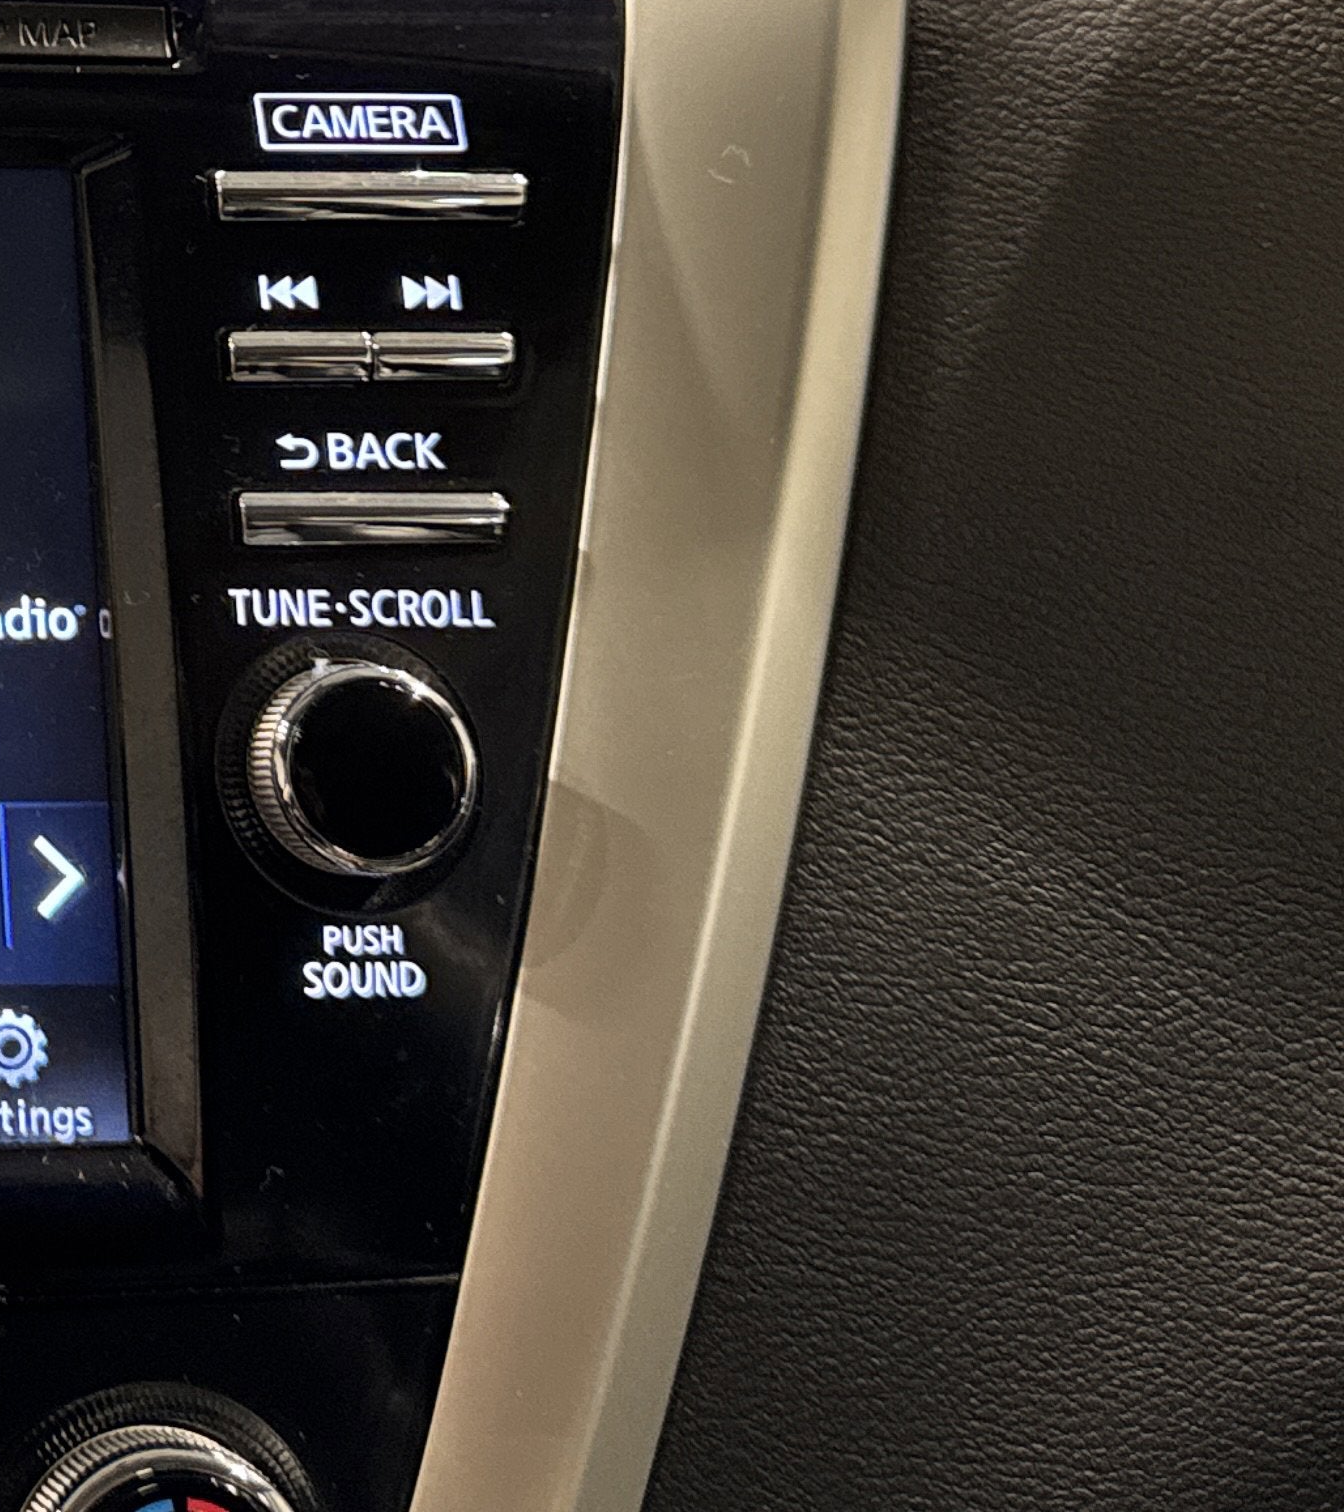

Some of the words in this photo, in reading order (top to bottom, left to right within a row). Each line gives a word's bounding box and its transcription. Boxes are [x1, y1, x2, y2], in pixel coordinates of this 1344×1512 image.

[17, 18, 98, 50] MAP
[271, 104, 453, 140] CAMERA
[326, 432, 446, 470] BACK
[322, 924, 404, 956] PUSH
[302, 960, 427, 999] SOUND
